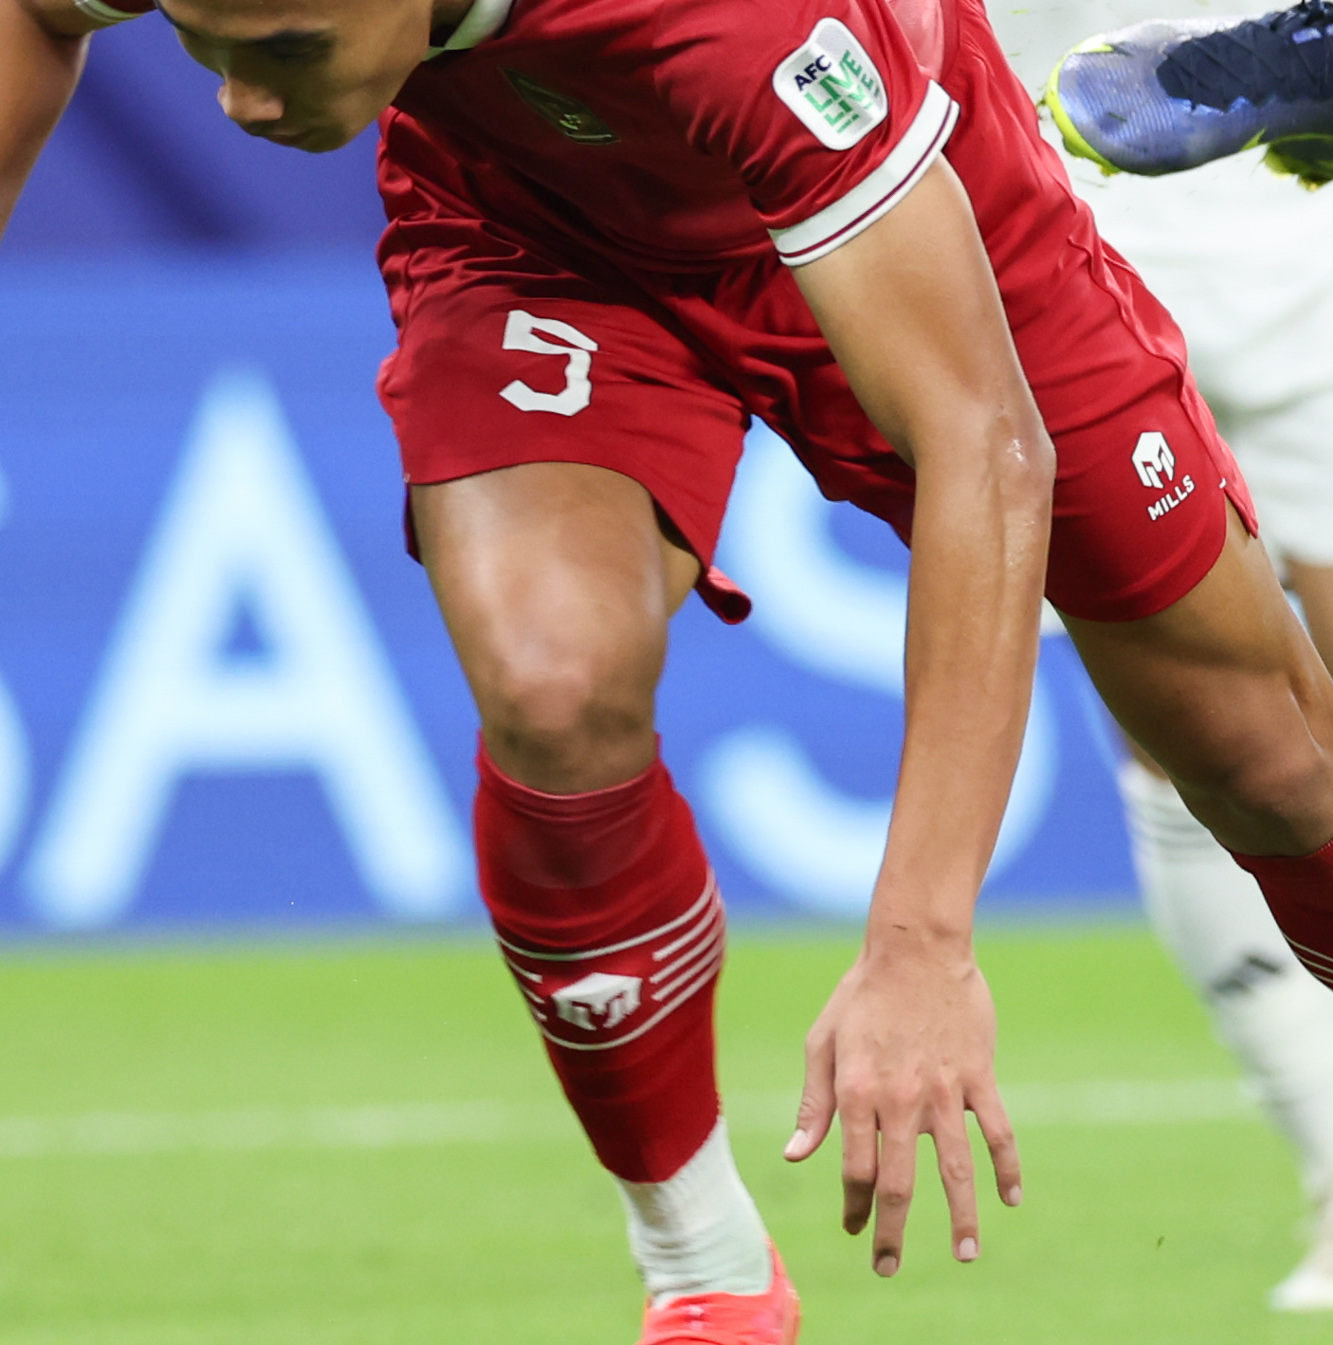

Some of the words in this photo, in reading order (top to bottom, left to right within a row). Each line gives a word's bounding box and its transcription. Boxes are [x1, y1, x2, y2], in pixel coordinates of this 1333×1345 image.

[793, 54, 832, 92] AFC
[499, 309, 599, 417] 5
[1147, 474, 1196, 522] MILLS
